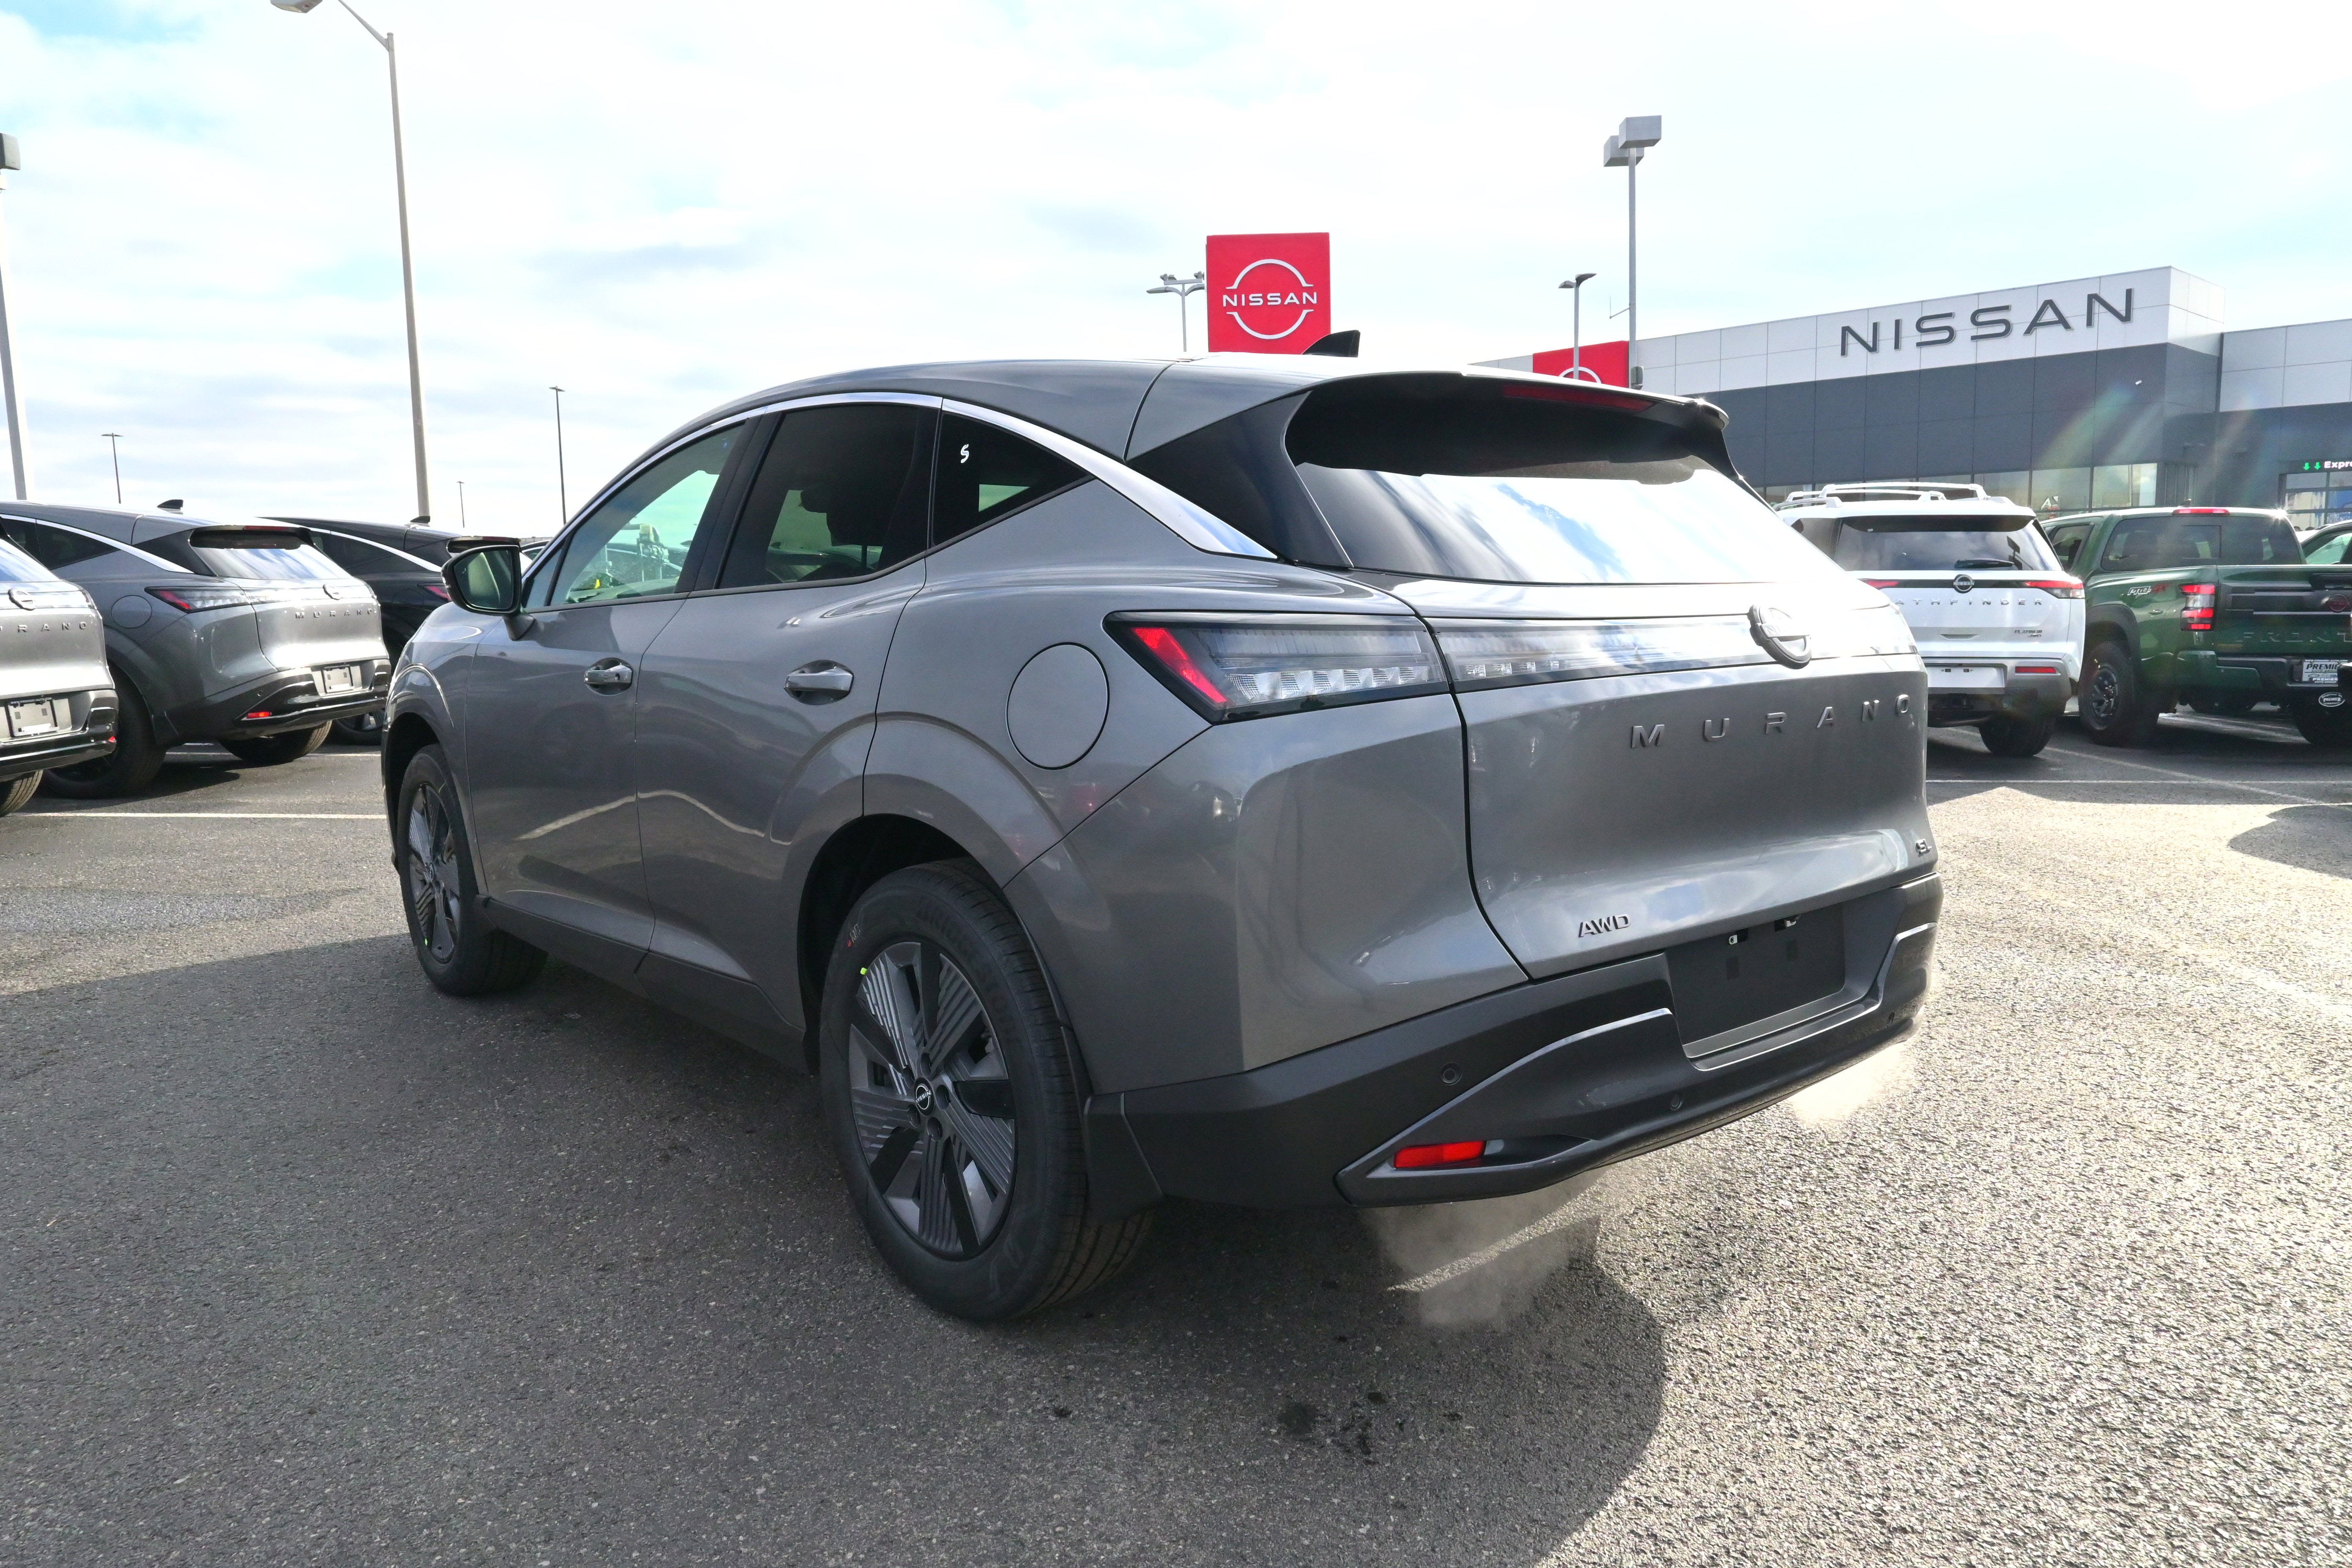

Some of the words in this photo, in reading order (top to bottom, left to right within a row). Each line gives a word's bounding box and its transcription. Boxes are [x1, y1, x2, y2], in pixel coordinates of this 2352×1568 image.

[1222, 291, 1317, 307] NISSAN
[1841, 288, 2134, 357] NISSAN
[295, 608, 372, 619] MURANO
[1631, 694, 1911, 749] MURANO
[1578, 913, 1631, 938] AWD
[915, 1090, 931, 1103] NISSAN
